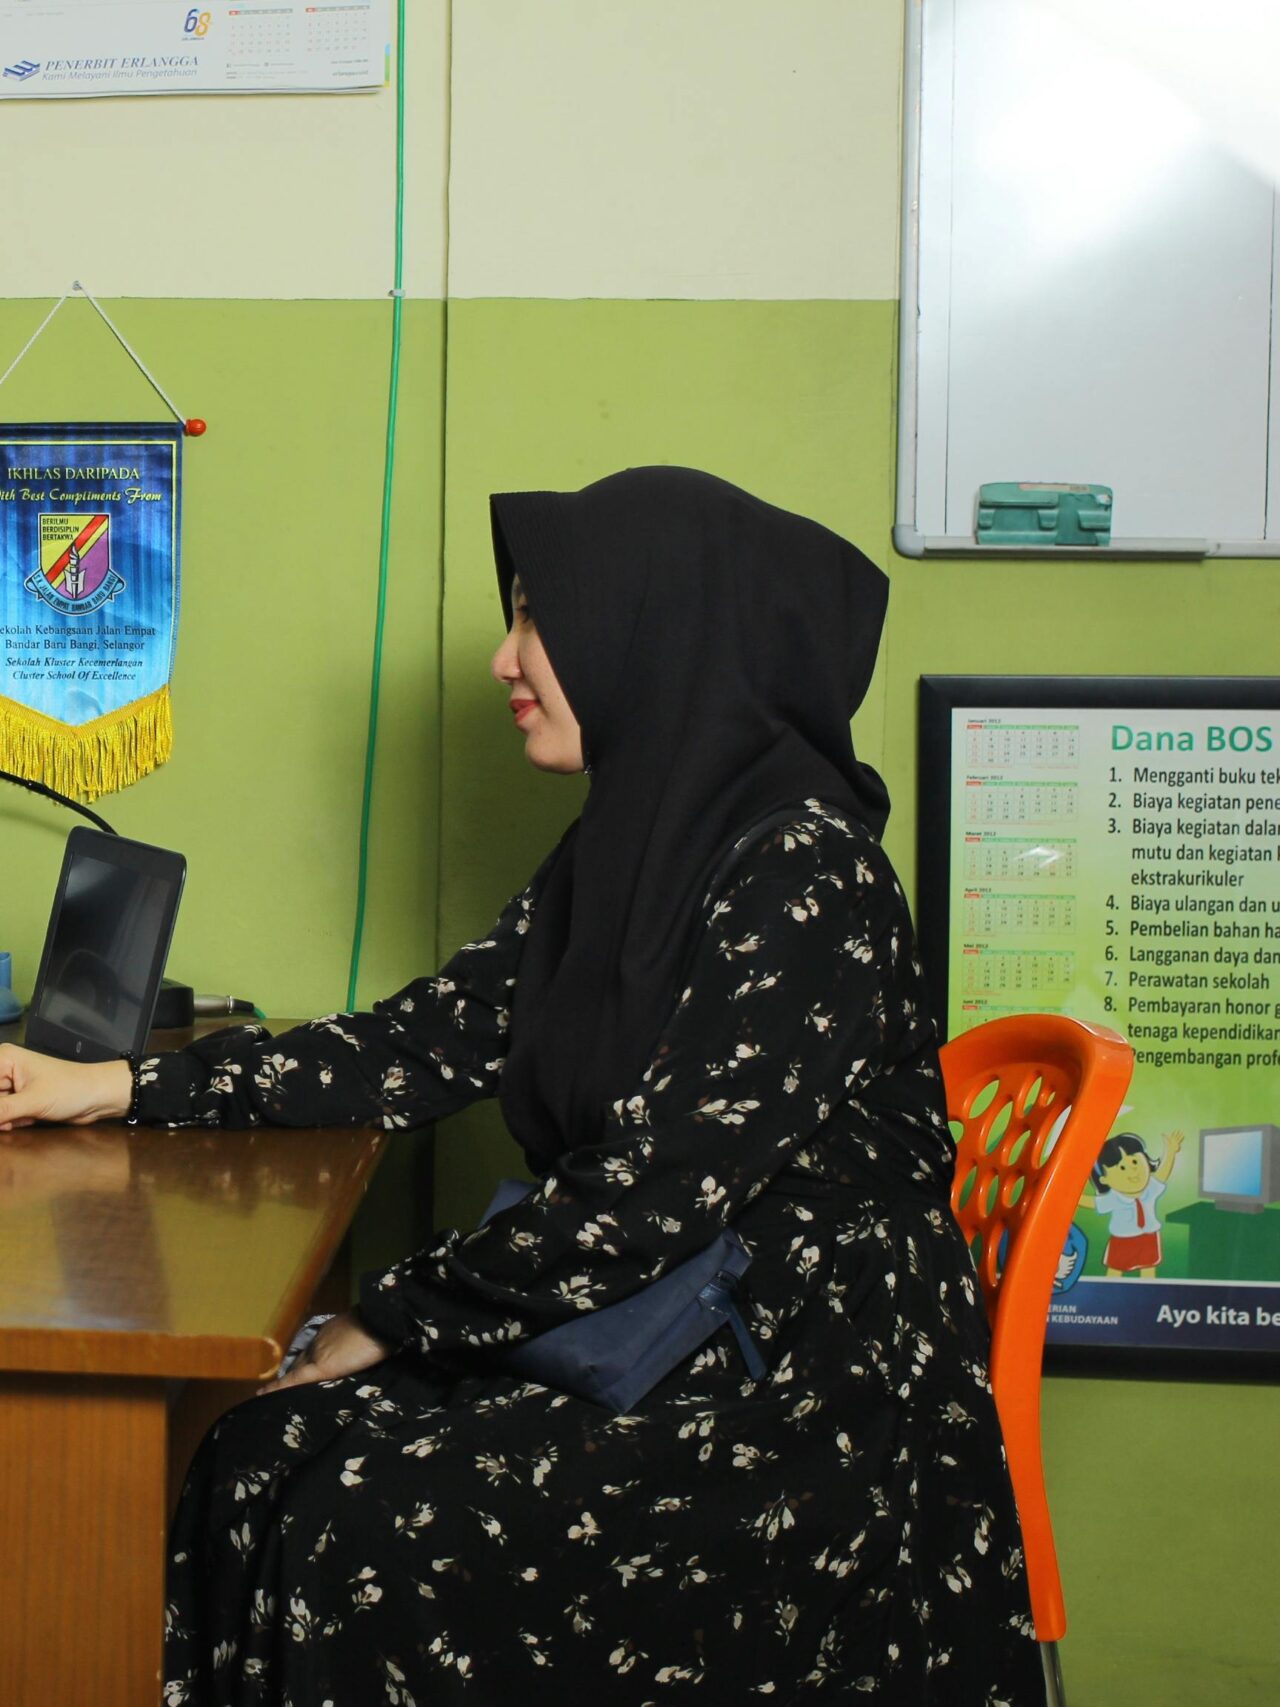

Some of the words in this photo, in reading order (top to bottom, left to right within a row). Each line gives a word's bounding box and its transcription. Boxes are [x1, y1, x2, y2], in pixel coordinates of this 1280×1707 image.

[184, 8, 211, 36] 68
[45, 58, 118, 71] PENERBIT
[121, 56, 199, 68] ERLANGGA
[42, 72, 66, 81] Kami
[70, 71, 111, 82] Melayani
[136, 68, 198, 79] Pengetahuan
[7, 467, 62, 480] IKHLAS
[64, 467, 141, 480] DARIPADA
[19, 488, 45, 501] Best
[49, 488, 122, 505] Compliments
[124, 486, 162, 504] From
[42, 518, 69, 526] BERILMU
[42, 526, 80, 534] BERDISIPLIN
[35, 624, 93, 637] Kebangsaan
[96, 625, 121, 636] Jalan
[124, 626, 156, 638] Empat
[5, 640, 40, 650] Bandar
[44, 640, 67, 650] Baru
[103, 640, 146, 652] Selangor
[5, 657, 41, 667] Sekolah
[44, 657, 76, 667] Kluster
[78, 657, 144, 669] Kecemerlangan
[12, 670, 44, 680] Cluster
[46, 670, 76, 680] School
[78, 670, 90, 680] Of
[92, 670, 137, 680] Excellence
[1111, 725, 1195, 752] Dana
[1206, 726, 1273, 752] BOS
[1109, 766, 1122, 783] 1.
[1133, 767, 1214, 787] Mengganti
[1218, 768, 1256, 784] buku
[1108, 792, 1122, 808] 2.
[1133, 792, 1172, 812] Biaya
[1178, 792, 1241, 813] kegiatan
[1108, 818, 1121, 834] 3.
[1132, 818, 1172, 838] Biaya
[1177, 818, 1240, 839] kegiatan
[1245, 819, 1280, 836] dala
[1132, 845, 1172, 860] mutu
[1176, 844, 1204, 860] dan
[1209, 844, 1272, 865] kegiatan
[1131, 868, 1244, 887] ekstrakurikuler
[1106, 894, 1120, 910] 4.
[1130, 895, 1170, 914] Biaya
[1175, 896, 1234, 916] ulangan
[1239, 896, 1266, 913] dan
[1106, 920, 1119, 936] 5.
[1130, 920, 1209, 938] Pembelian
[1214, 921, 1260, 938] bahan
[1105, 945, 1118, 962] 6.
[1130, 946, 1209, 966] Langganan
[1214, 947, 1249, 967] daya
[1104, 970, 1118, 987] 7.
[1129, 971, 1208, 988] Perawatan
[1213, 972, 1270, 990] sekolah
[1104, 996, 1118, 1012] 8.
[1128, 996, 1220, 1017] Pembayaran
[1226, 998, 1271, 1015] honor
[1128, 1023, 1178, 1042] tenaga
[1051, 1315, 1119, 1326] KEBUDAYAAN
[1156, 1304, 1201, 1328] Ayo
[1206, 1306, 1250, 1326] kita
